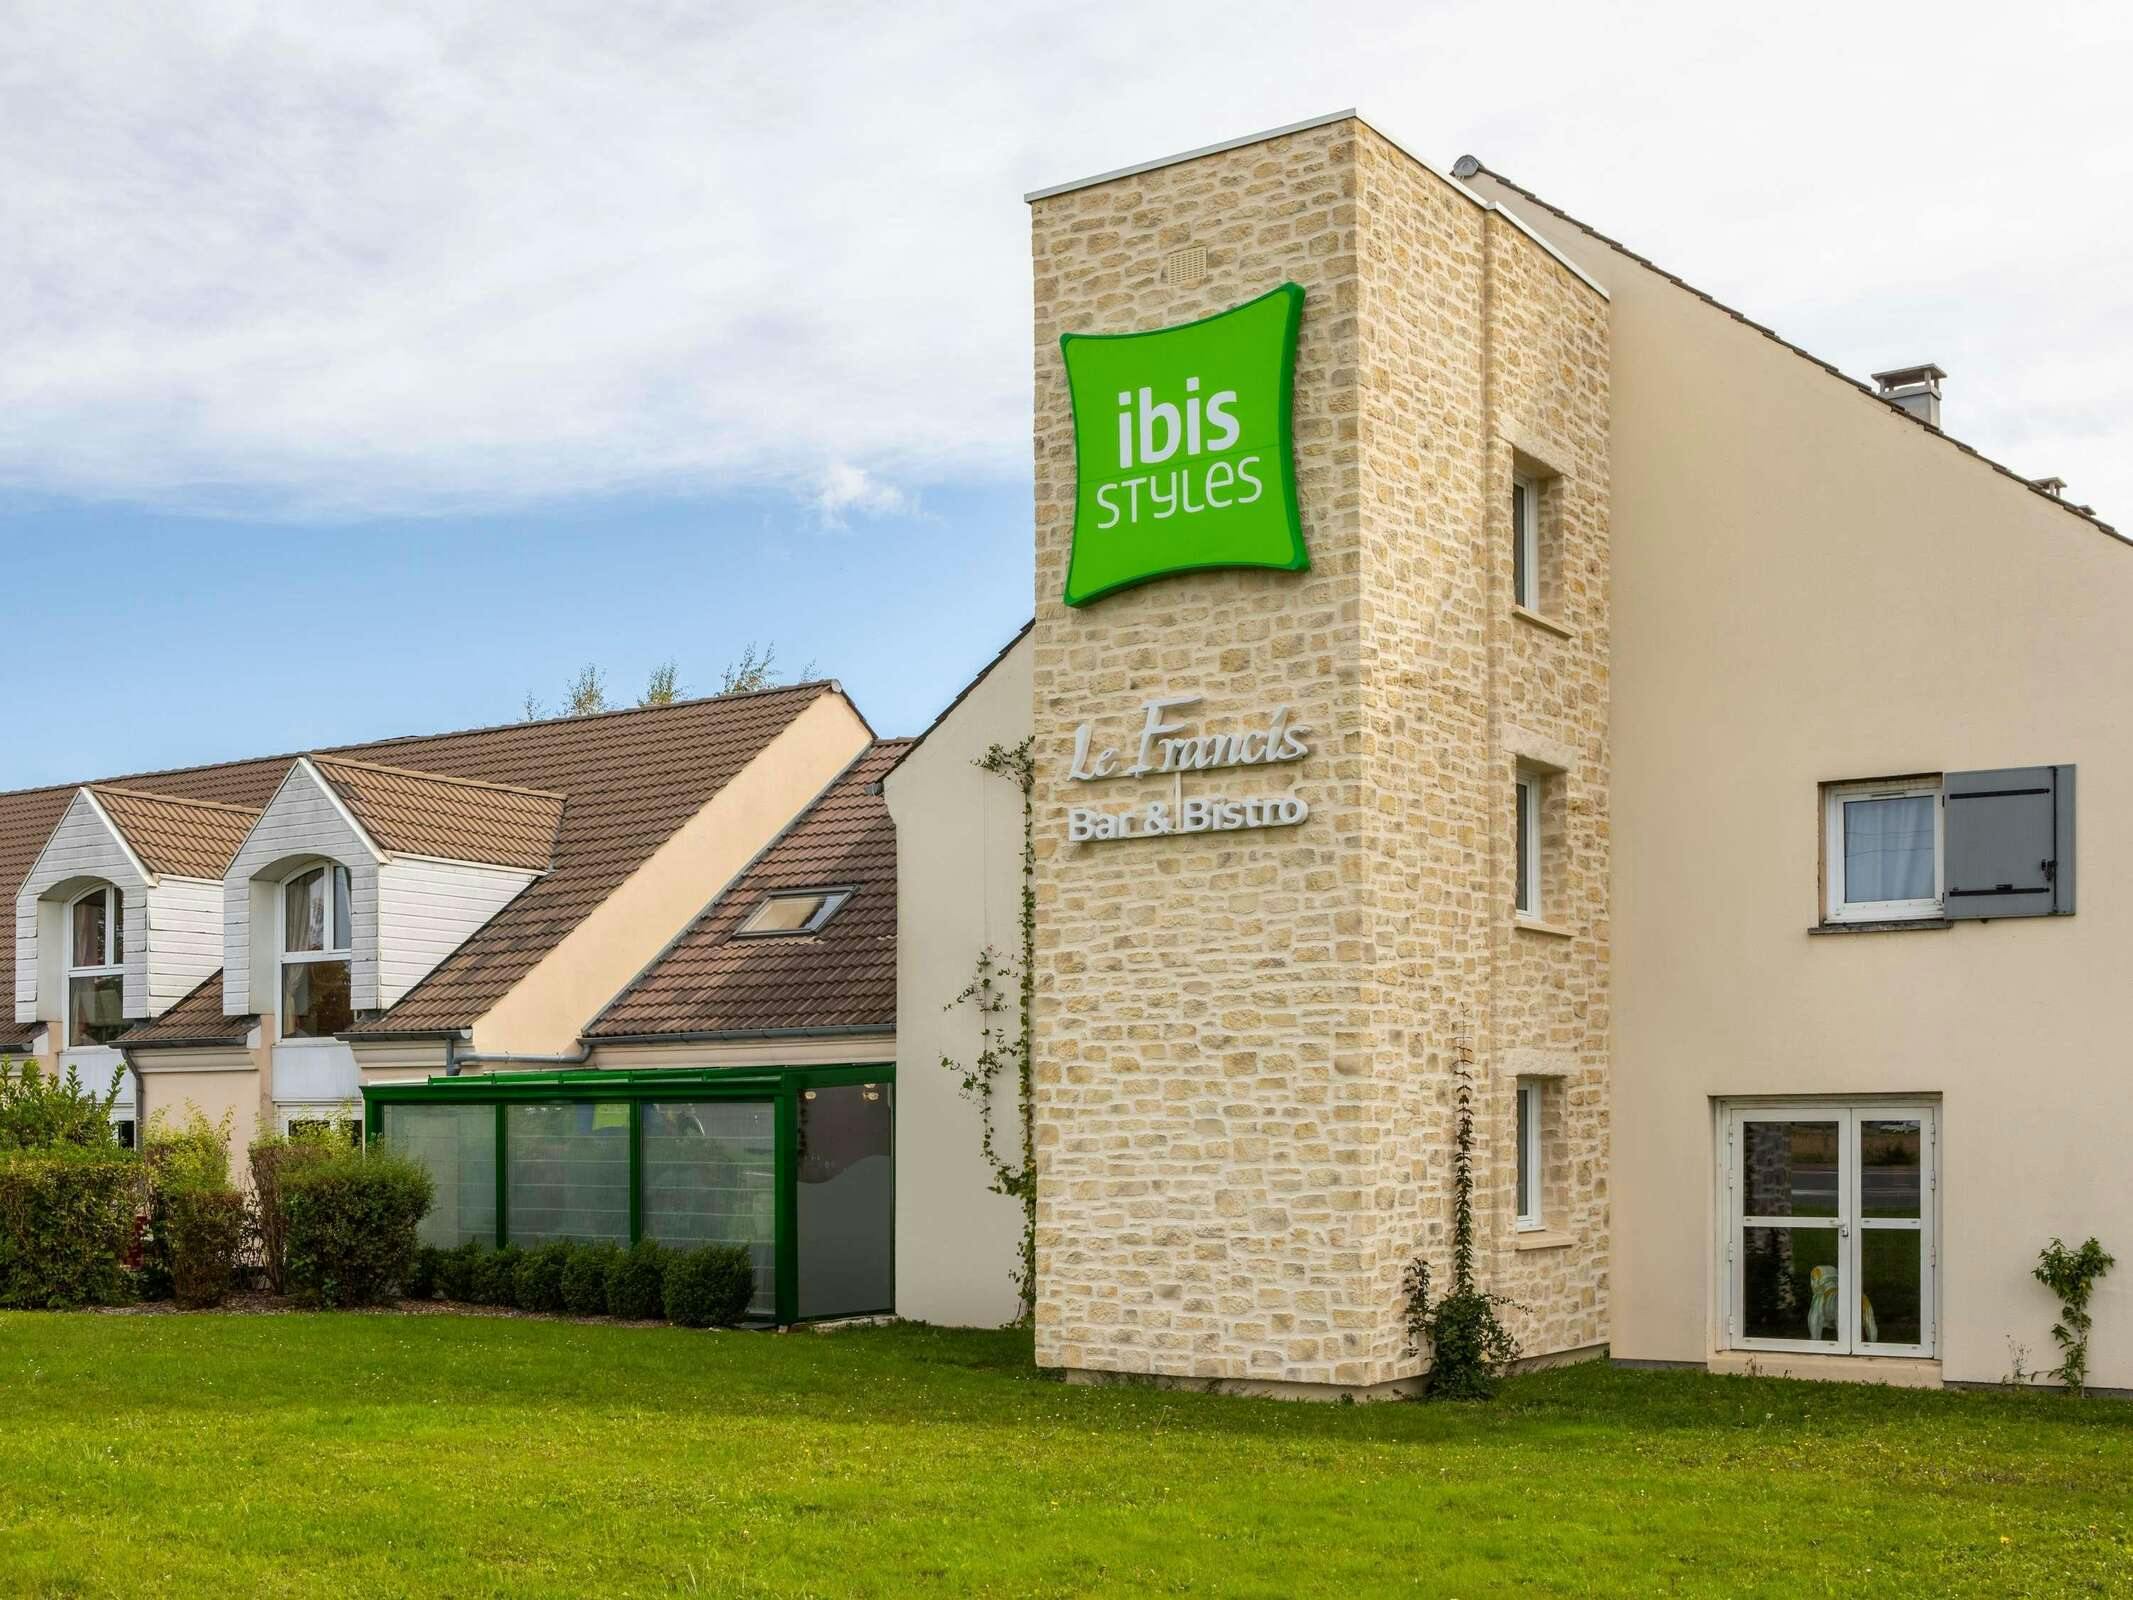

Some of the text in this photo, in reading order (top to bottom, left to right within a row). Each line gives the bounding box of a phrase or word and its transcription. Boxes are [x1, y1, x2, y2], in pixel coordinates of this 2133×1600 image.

[1117, 376, 1240, 469] ibis
[1067, 695, 1311, 780] Le Francis
[1069, 795, 1309, 841] Bar & Bistro
